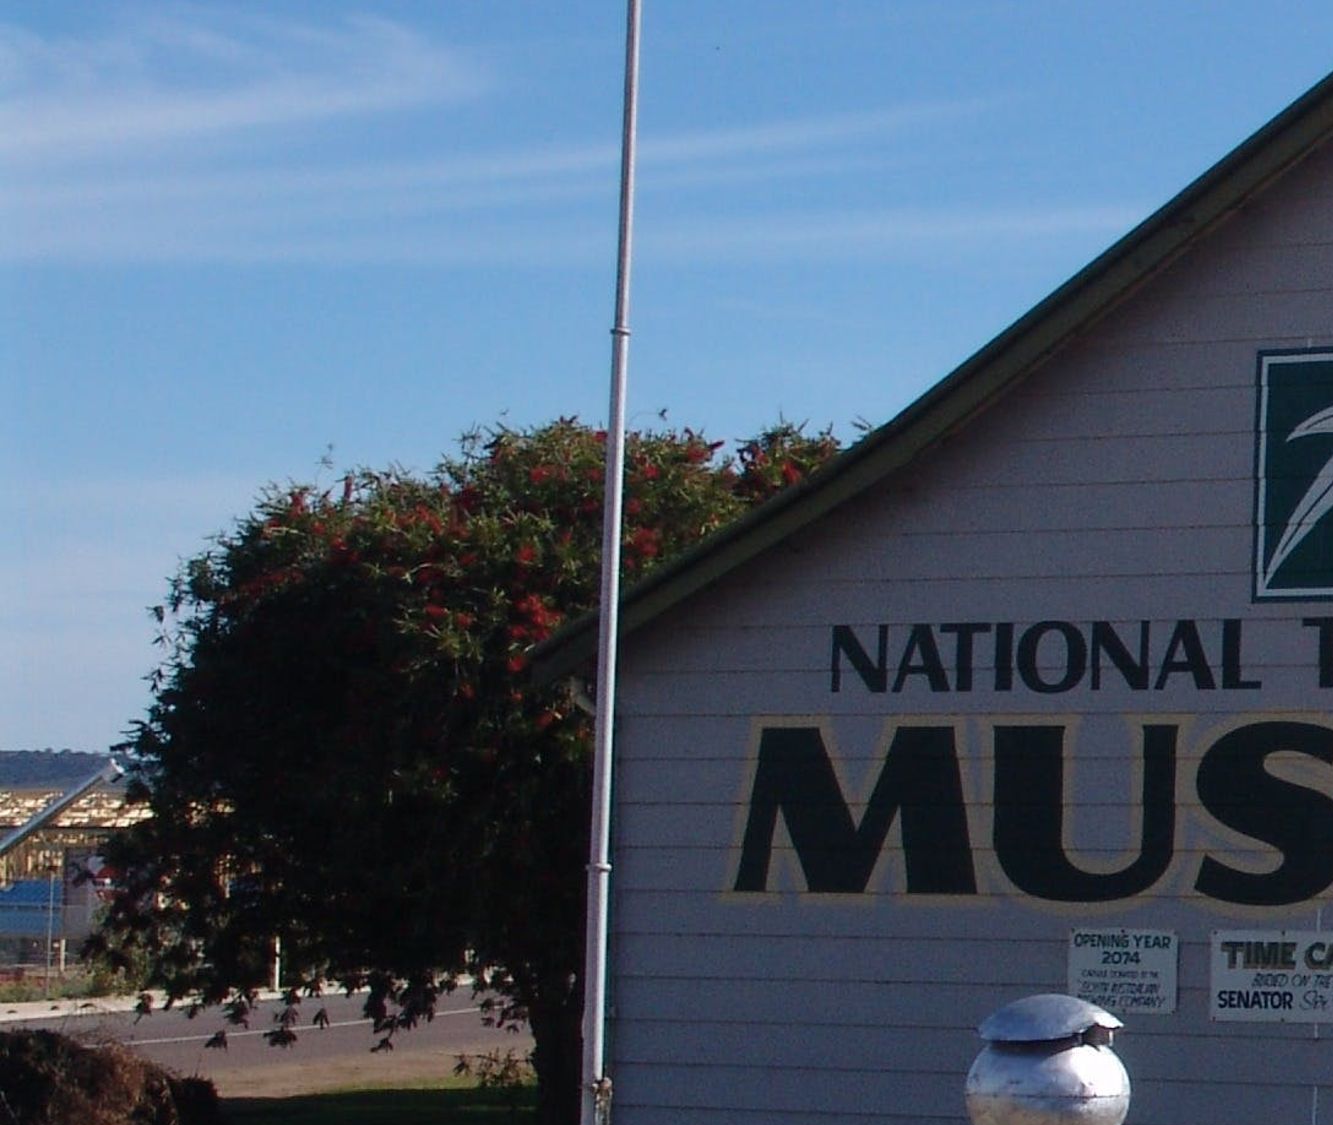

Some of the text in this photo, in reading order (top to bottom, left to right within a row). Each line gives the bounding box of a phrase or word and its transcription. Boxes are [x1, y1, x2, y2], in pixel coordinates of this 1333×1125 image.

[830, 618, 1262, 694] NATIONAL
[1074, 934, 1172, 949] OPENING YEAR
[1101, 950, 1141, 965] 2074
[1220, 941, 1298, 971] TIME
[1217, 990, 1294, 1010] SENATOR
